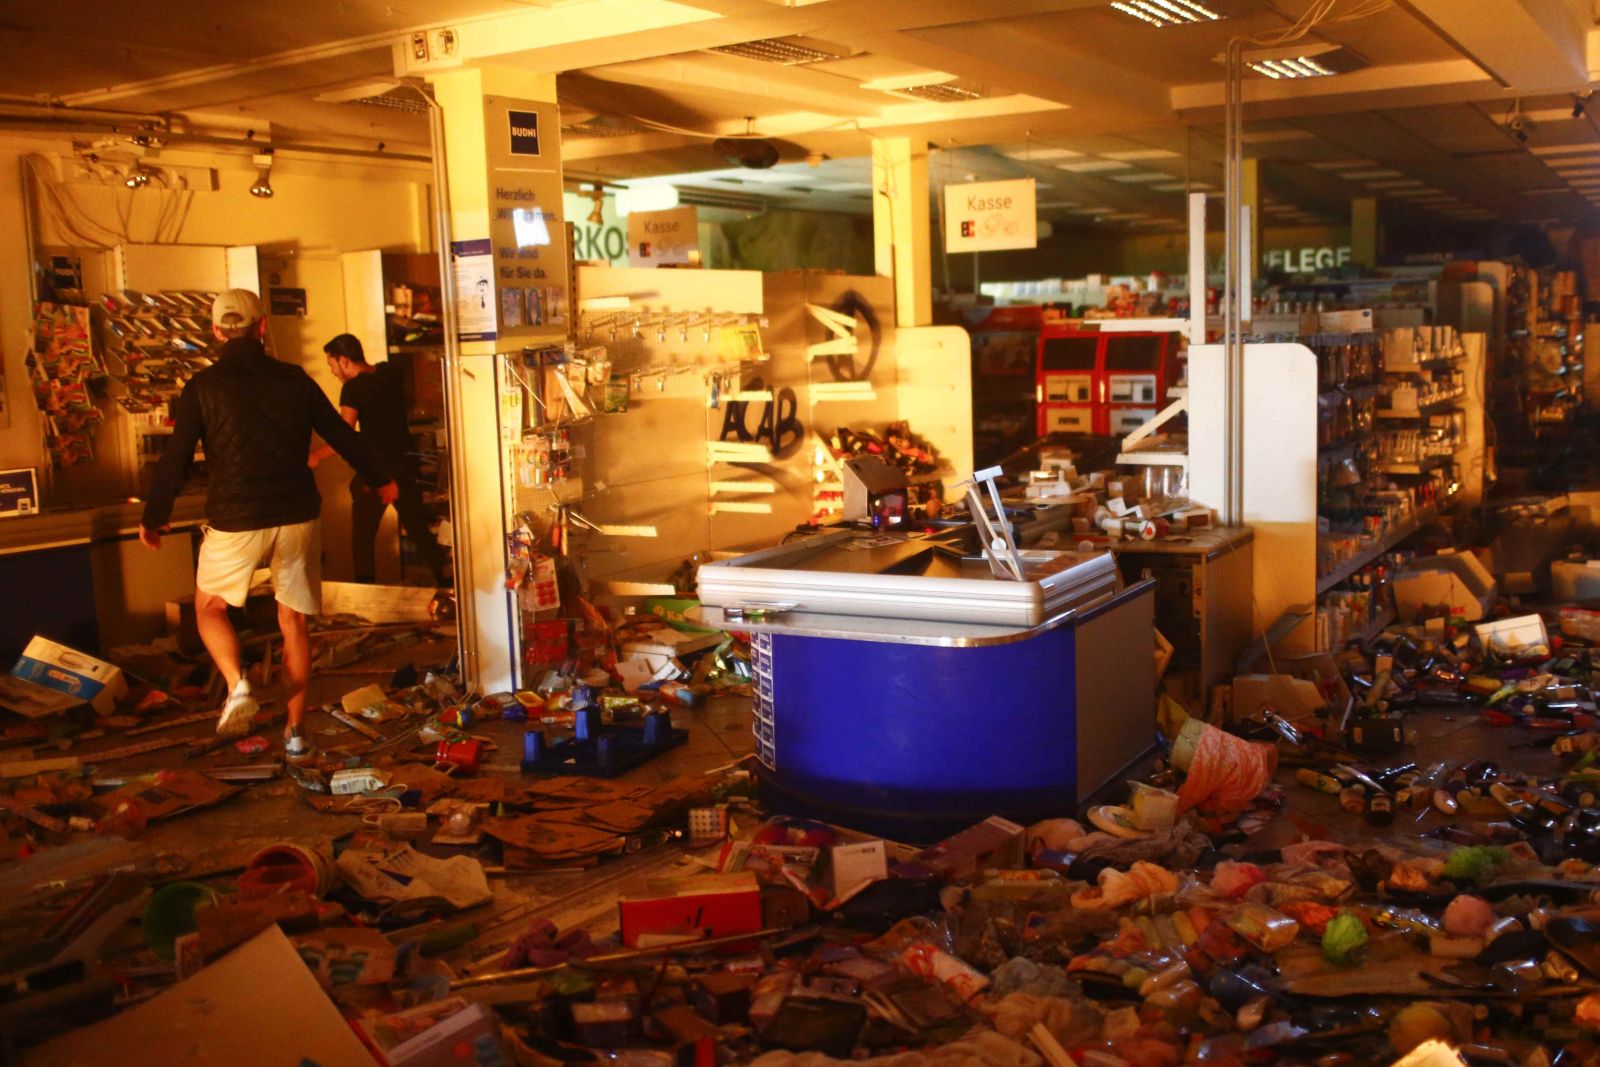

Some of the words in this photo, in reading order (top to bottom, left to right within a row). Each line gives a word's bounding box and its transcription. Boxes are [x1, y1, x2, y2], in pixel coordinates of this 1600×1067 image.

[511, 126, 537, 138] BUDNI
[496, 187, 535, 201] Herzlich
[967, 195, 1012, 212] Kasse
[643, 220, 680, 236] Kasse
[574, 225, 629, 260] RKO
[499, 246, 515, 258] Wir
[518, 247, 538, 259] sind
[500, 265, 514, 278] für
[516, 265, 532, 279] Sie
[534, 267, 549, 279] da.
[719, 376, 804, 460] ACAB
